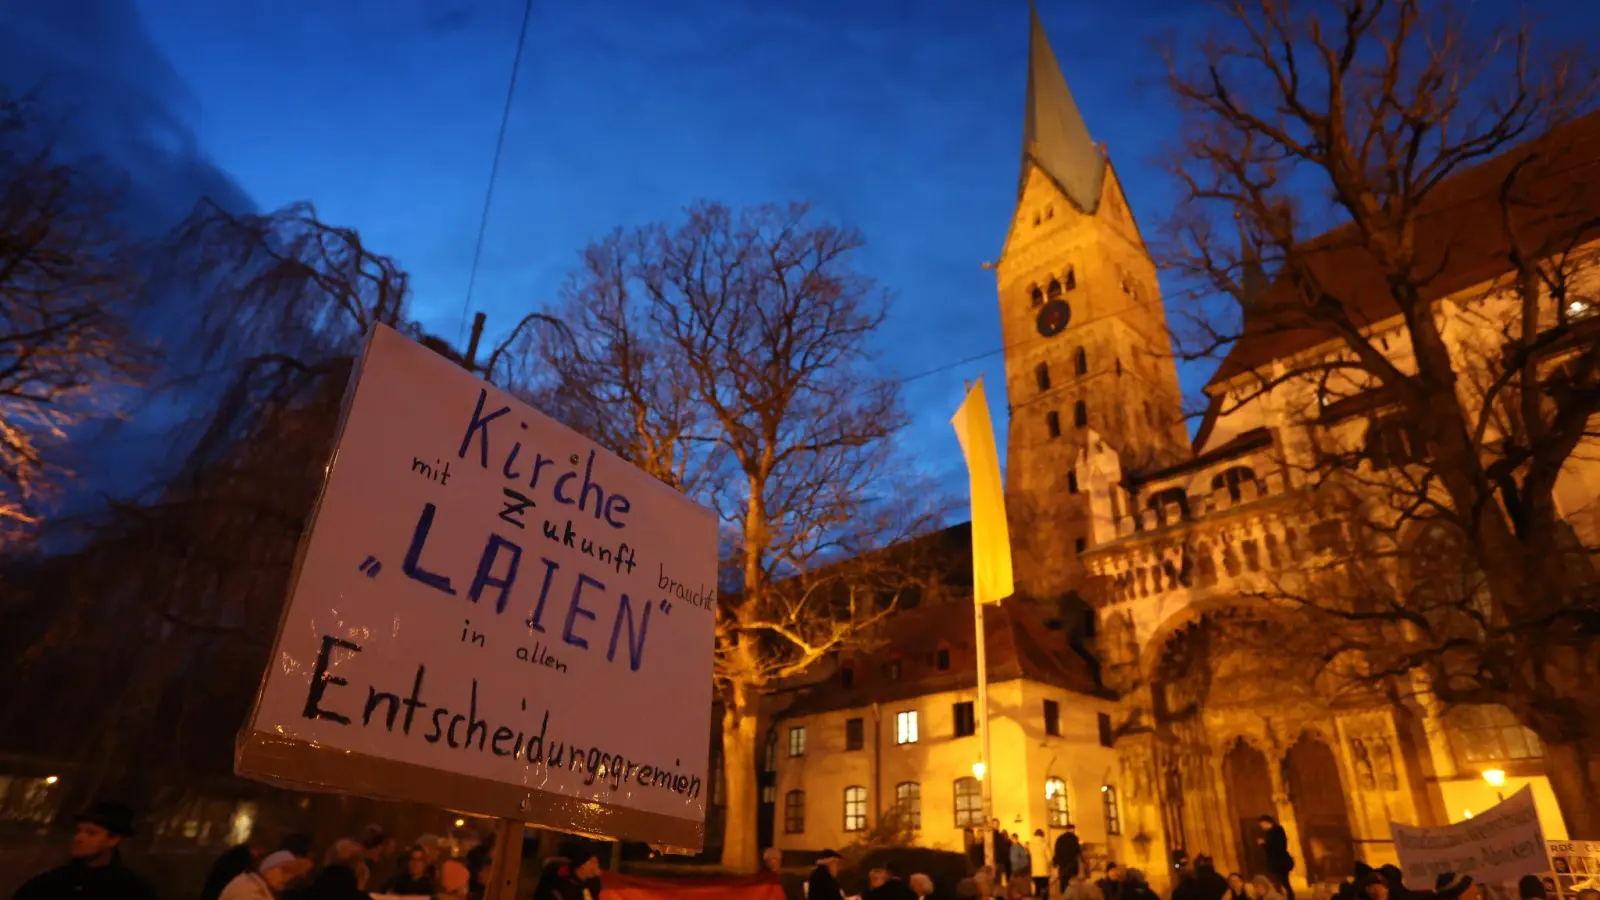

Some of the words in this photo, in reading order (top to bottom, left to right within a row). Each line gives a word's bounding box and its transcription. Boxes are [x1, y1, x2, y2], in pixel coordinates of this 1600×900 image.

[458, 388, 632, 528] Kirche
[412, 456, 452, 486] mit
[499, 487, 636, 574] Zukunft
[658, 563, 714, 612] braucht
[303, 635, 701, 799] Entscheidungsgremien
[461, 620, 485, 647] in
[516, 642, 567, 673] allen
